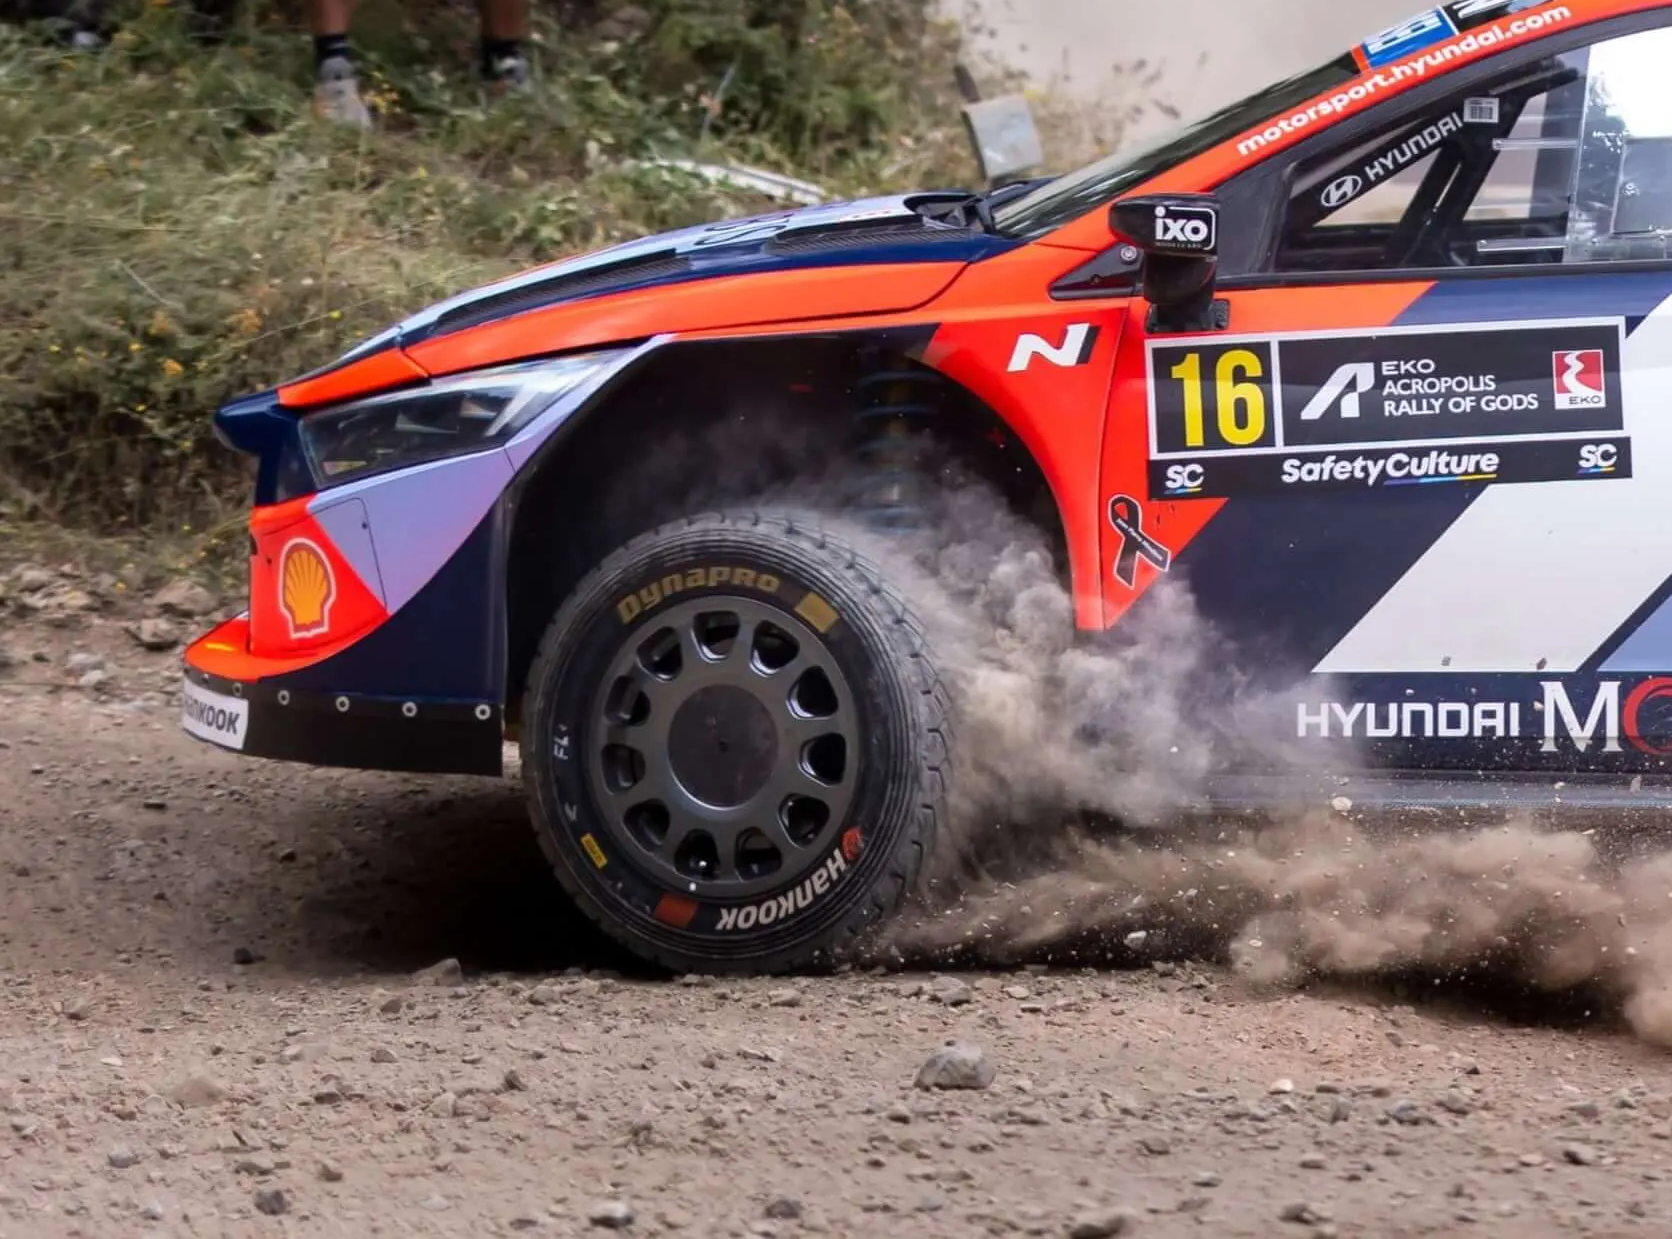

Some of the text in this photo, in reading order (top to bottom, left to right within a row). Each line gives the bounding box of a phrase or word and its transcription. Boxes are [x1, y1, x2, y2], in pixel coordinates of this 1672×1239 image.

[1237, 3, 1571, 157] motorsport.hyundai.com
[1365, 112, 1463, 182] HYUNDAI
[1381, 359, 1436, 375] EKO
[1170, 349, 1265, 447] 16
[1382, 374, 1496, 396] ACROPOLIS
[1568, 395, 1602, 406] EKO
[1384, 393, 1539, 417] RALLY OF GODS
[1281, 450, 1499, 485] SafetyCulture
[1296, 702, 1520, 738] HYUNDAI
